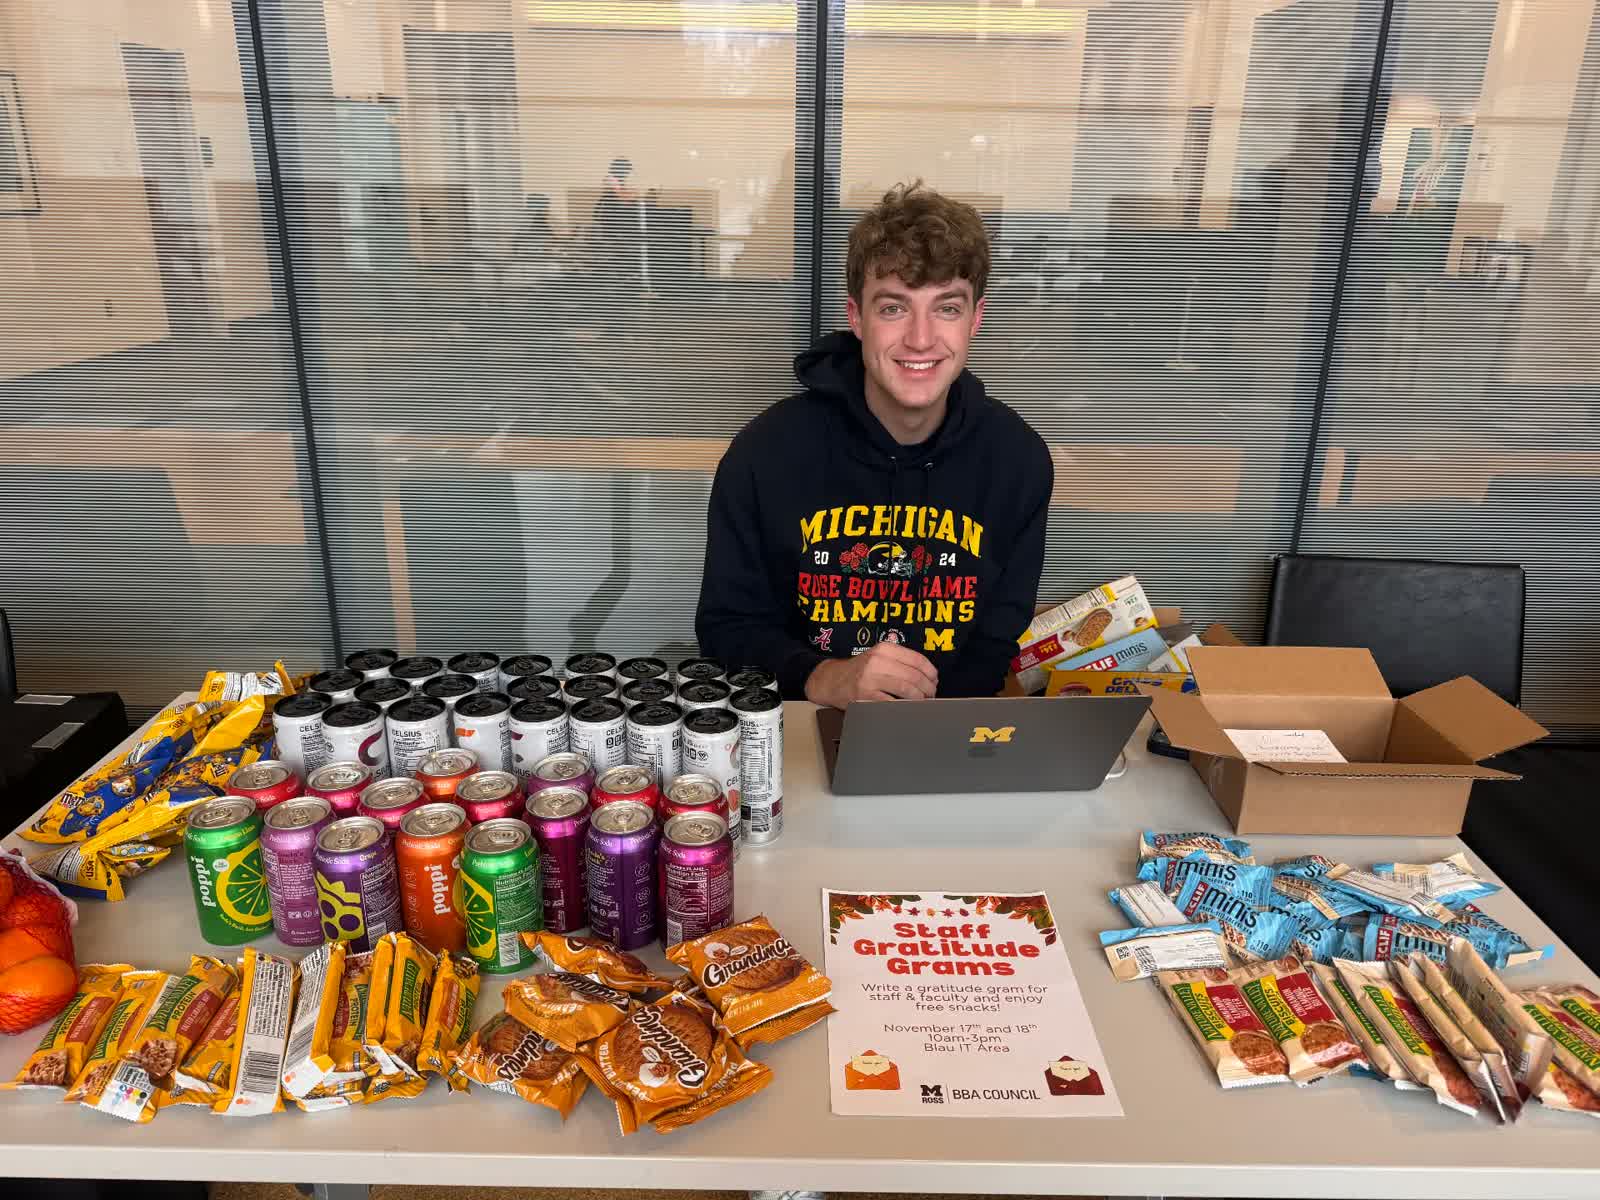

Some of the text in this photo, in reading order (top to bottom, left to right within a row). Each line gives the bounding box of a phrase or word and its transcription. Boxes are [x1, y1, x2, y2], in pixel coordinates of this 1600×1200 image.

[800, 505, 984, 558] MICHIGAN
[814, 551, 829, 565] 20
[939, 552, 957, 566] 24
[798, 572, 842, 598] ROSE
[847, 576, 912, 602] BOWL
[923, 627, 955, 652] M
[1115, 641, 1148, 662] minis
[300, 723, 321, 733] CELSI
[392, 728, 422, 738] CELSIUS
[969, 726, 1017, 743] M
[1176, 861, 1238, 882] minis
[190, 855, 217, 908] poppi
[423, 863, 451, 916] poppi
[1188, 882, 1207, 909] CLIF
[1241, 889, 1253, 899] 110
[1202, 886, 1260, 928] minis
[893, 923, 990, 939] Staff
[853, 938, 1040, 958] Gratitude
[1256, 939, 1269, 952] 110
[1378, 929, 1392, 953] CLIF
[886, 958, 1015, 976] Grams
[861, 983, 899, 992] Write
[917, 984, 982, 994] gratitude
[987, 986, 1023, 995] gram
[1028, 984, 1048, 994] for
[870, 992, 1043, 1004] staff & faculty and enjoy
[171, 991, 197, 1020] PROTEIN
[350, 998, 359, 1027] PROTEIN
[916, 1003, 1000, 1012] free snacks!
[1194, 993, 1225, 1029] BISCUITS
[1264, 988, 1296, 1026] BISCUITS
[109, 1012, 130, 1042] PROTEIN
[884, 1024, 1037, 1034] November 17th and 18th
[924, 1043, 1010, 1053] Blau IT Area
[928, 1034, 1001, 1044] 10am-3pm
[496, 1030, 544, 1082] ndma's
[920, 1085, 943, 1096] M
[953, 1089, 1041, 1100] BBA COUNCIL
[922, 1096, 944, 1104] ROSS
